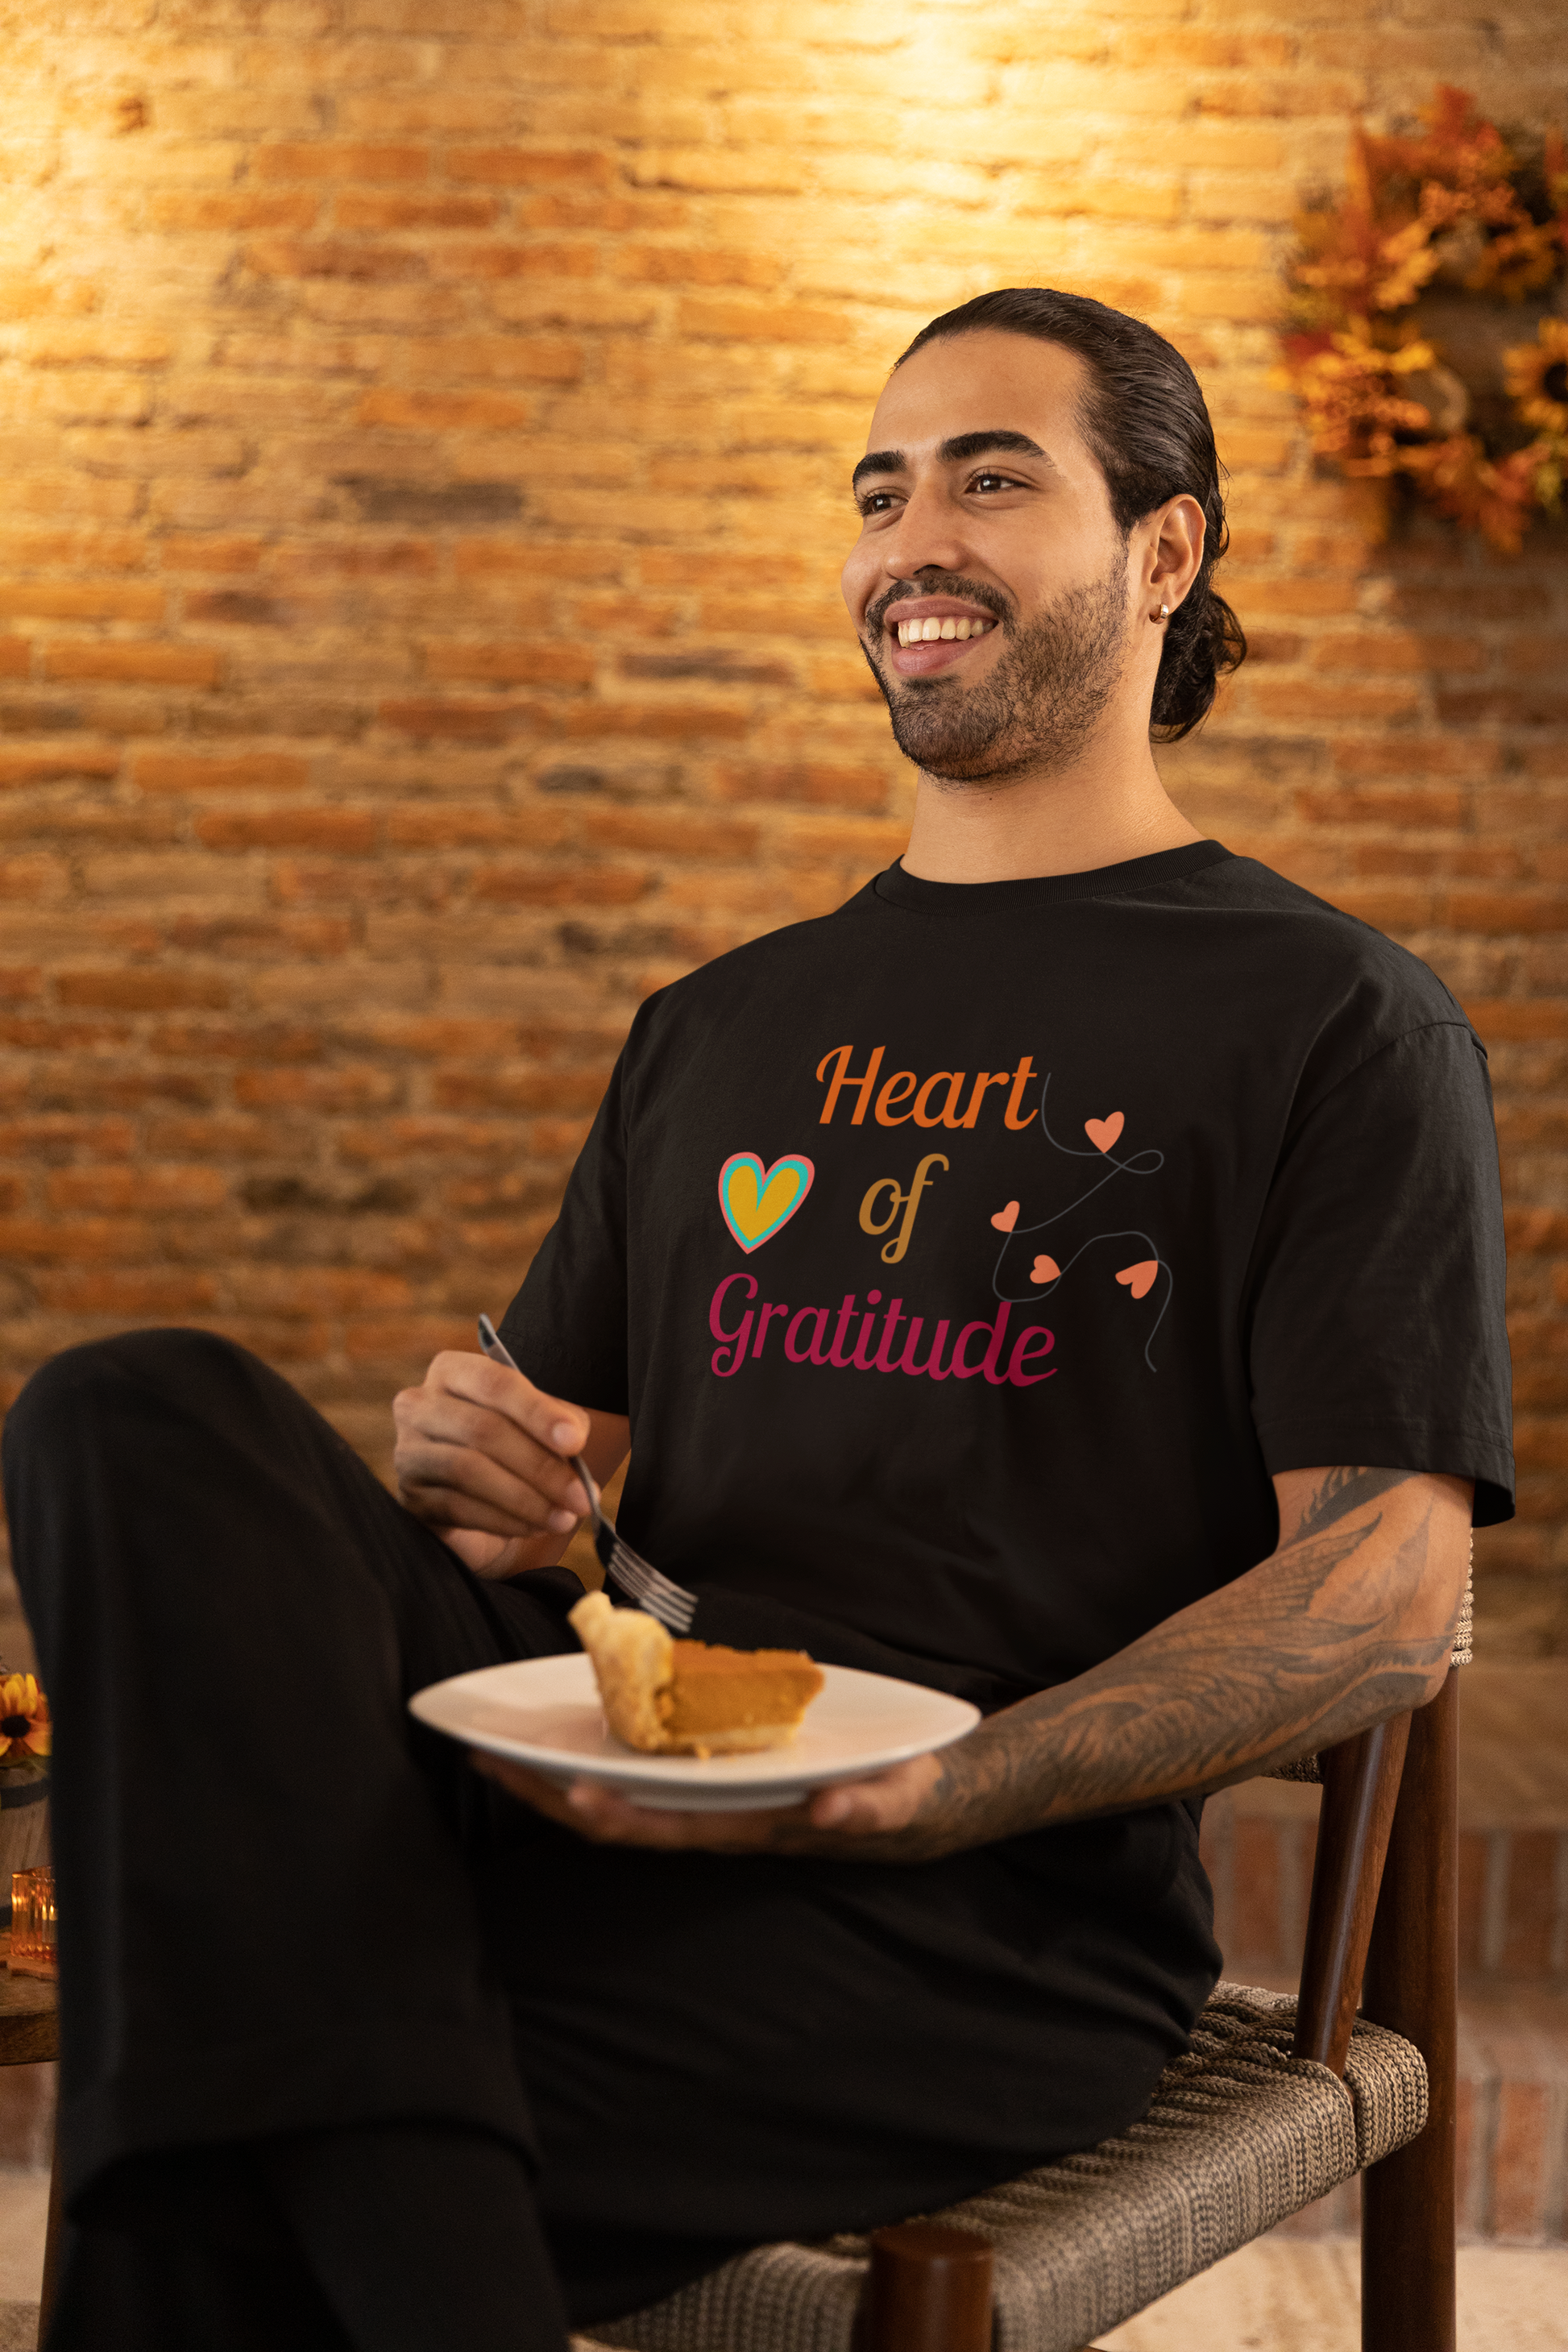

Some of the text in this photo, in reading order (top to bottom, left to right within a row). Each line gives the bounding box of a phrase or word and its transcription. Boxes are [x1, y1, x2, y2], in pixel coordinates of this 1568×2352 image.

[815, 1044, 1039, 1130] Heart
[858, 1153, 950, 1264] of
[708, 1272, 1059, 1387] Gratitude
